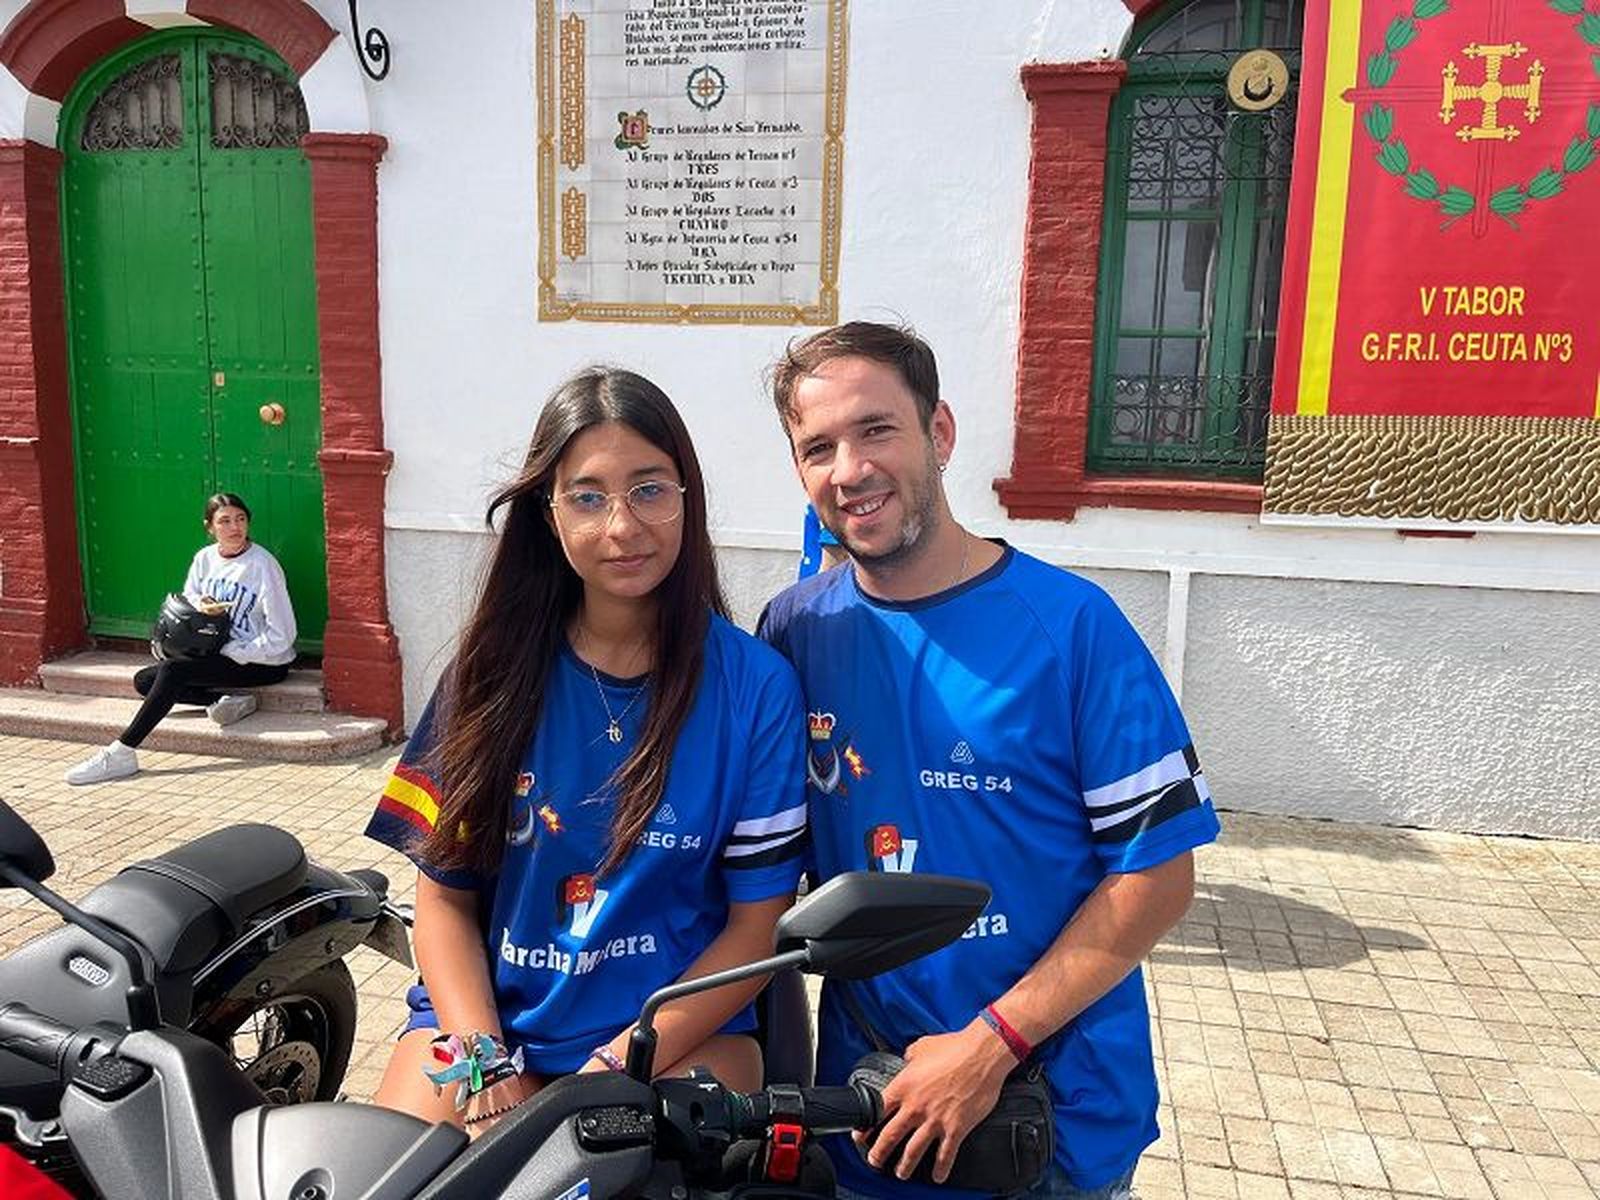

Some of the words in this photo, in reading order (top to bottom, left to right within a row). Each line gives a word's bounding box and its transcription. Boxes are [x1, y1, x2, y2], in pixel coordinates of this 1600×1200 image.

[794, 15, 805, 26] de
[747, 28, 761, 39] las
[722, 122, 733, 134] de
[735, 121, 754, 133] San
[673, 152, 684, 161] de
[684, 149, 731, 162] Regulares
[735, 151, 746, 161] de
[688, 163, 719, 175] TRES
[641, 177, 669, 191] Grupo
[673, 178, 683, 189] de
[683, 177, 731, 190] Regulares
[735, 176, 745, 189] de
[748, 177, 777, 189] Ceuta
[691, 191, 716, 203] DOS
[641, 205, 669, 218] Grupo
[673, 205, 683, 216] de
[683, 203, 731, 218] Regulares
[679, 219, 728, 230] CUATRO
[667, 234, 678, 244] de
[729, 234, 740, 244] de
[743, 233, 769, 245] Ceuta
[690, 246, 717, 258] UNA
[662, 273, 715, 286] TREINTA
[728, 273, 756, 285] UNA
[1420, 287, 1437, 316] V
[1442, 286, 1526, 317] TABOR
[1361, 332, 1441, 362] G.F.R.I.
[1448, 332, 1528, 362] CEUTA
[919, 769, 979, 791] GREG
[984, 775, 1014, 793] 54
[635, 831, 677, 849] REG
[680, 834, 702, 849] 54
[500, 926, 572, 976] archa
